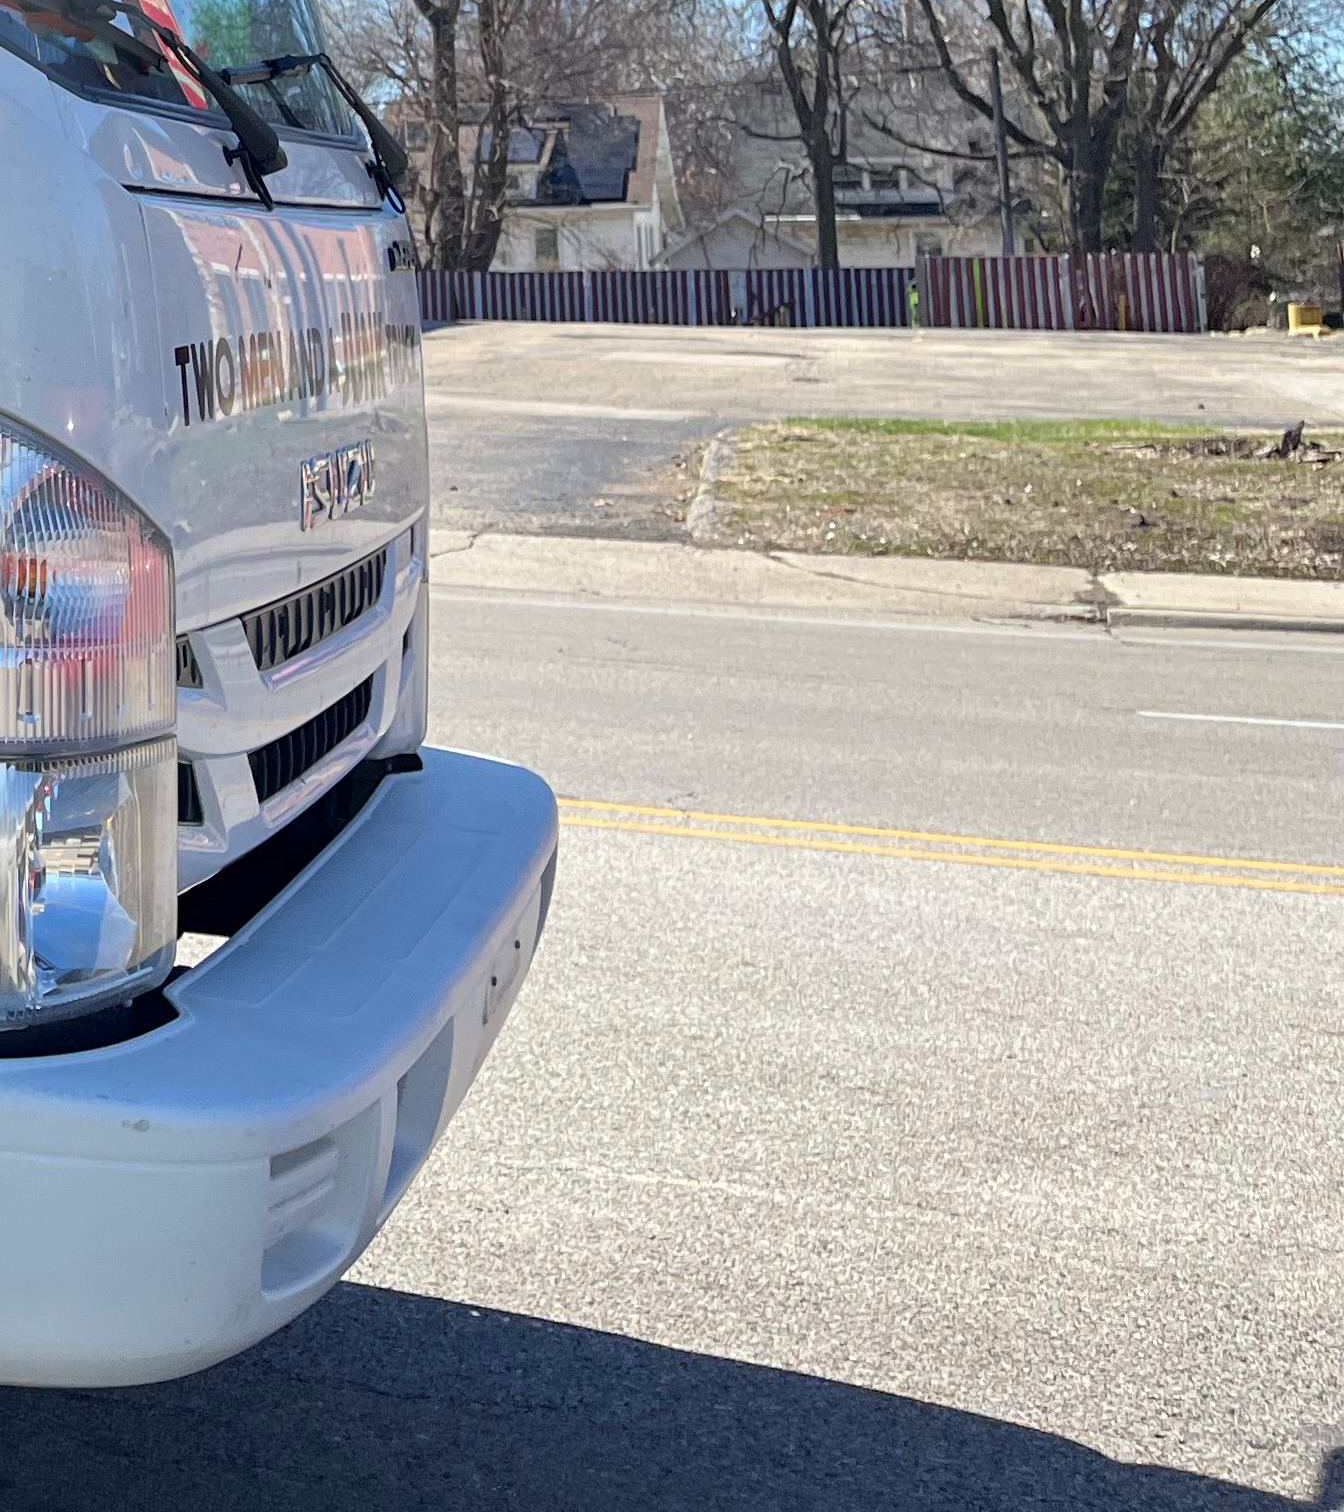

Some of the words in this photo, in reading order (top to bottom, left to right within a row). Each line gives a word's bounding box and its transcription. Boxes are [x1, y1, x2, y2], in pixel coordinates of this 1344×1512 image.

[175, 338, 235, 427] TWO
[239, 331, 285, 412] MEN
[289, 328, 325, 402] AND
